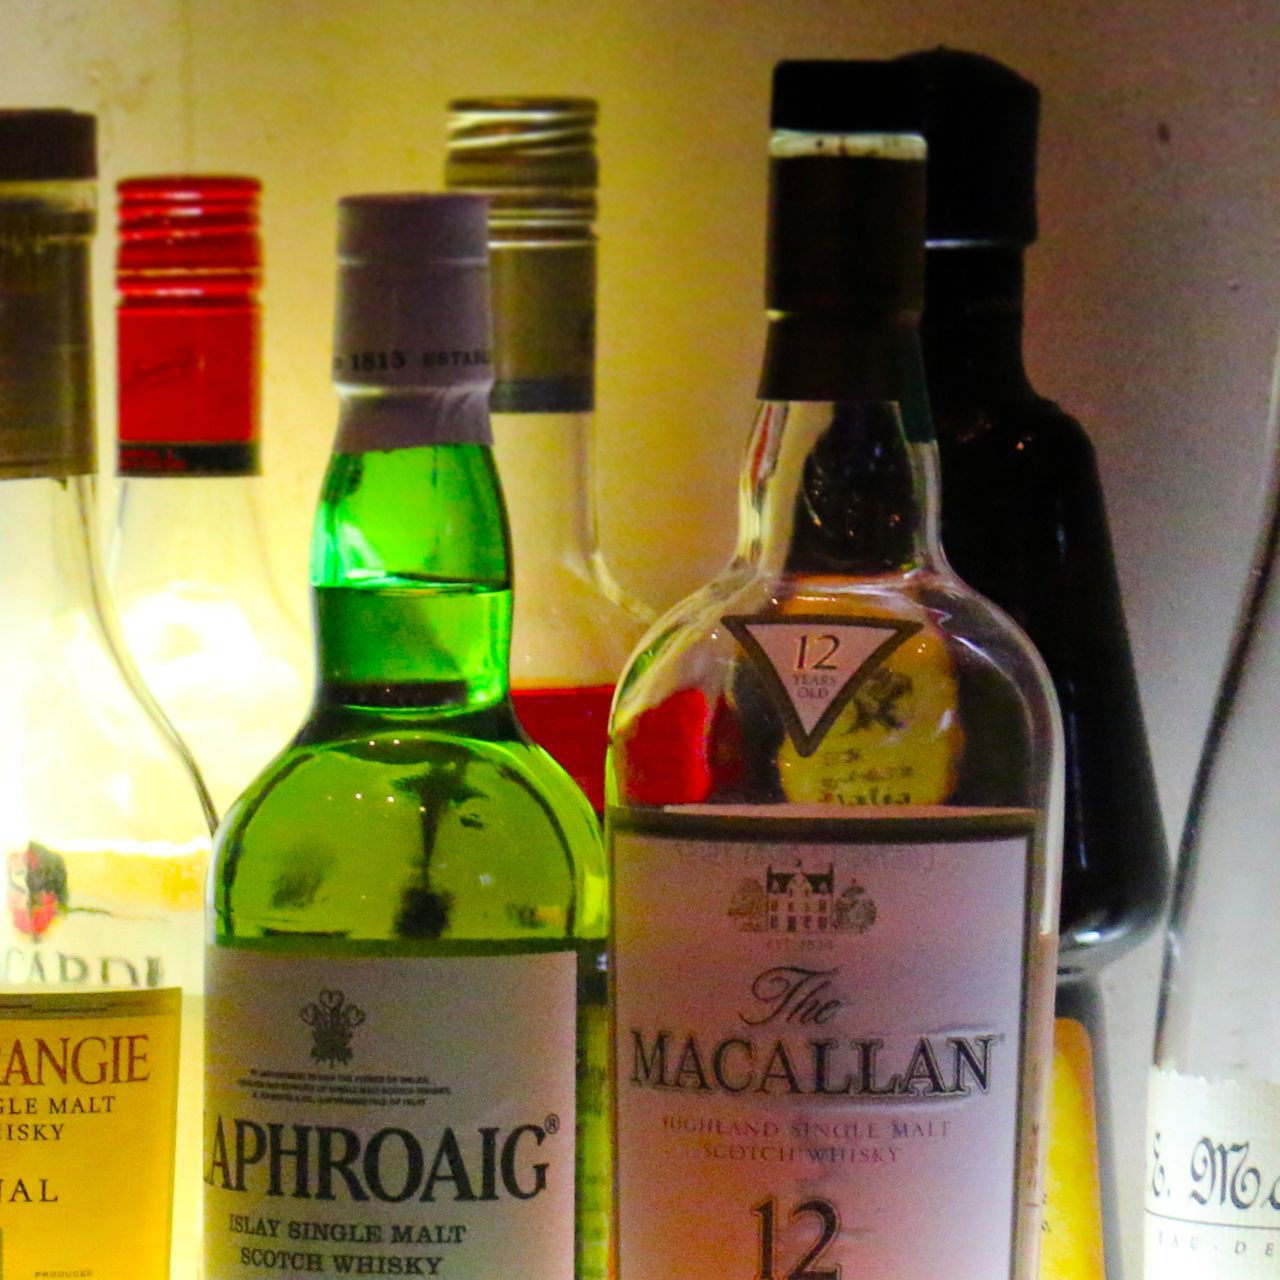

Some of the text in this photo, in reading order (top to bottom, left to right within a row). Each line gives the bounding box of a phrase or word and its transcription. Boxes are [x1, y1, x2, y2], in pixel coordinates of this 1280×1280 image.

[797, 634, 840, 670] 12
[793, 674, 837, 686] YEARS
[797, 687, 828, 698] OLD
[739, 966, 841, 1026] The
[630, 1028, 997, 1096] MACALLAN
[49, 1096, 117, 1114] MALT
[662, 1116, 952, 1139] HIGHLAND SINGLE MALT
[229, 1214, 467, 1245] ISLAY SINGLE MALT
[34, 1269, 95, 1279] PRODUCED
[240, 1247, 445, 1276] SCOTCH WHISKY
